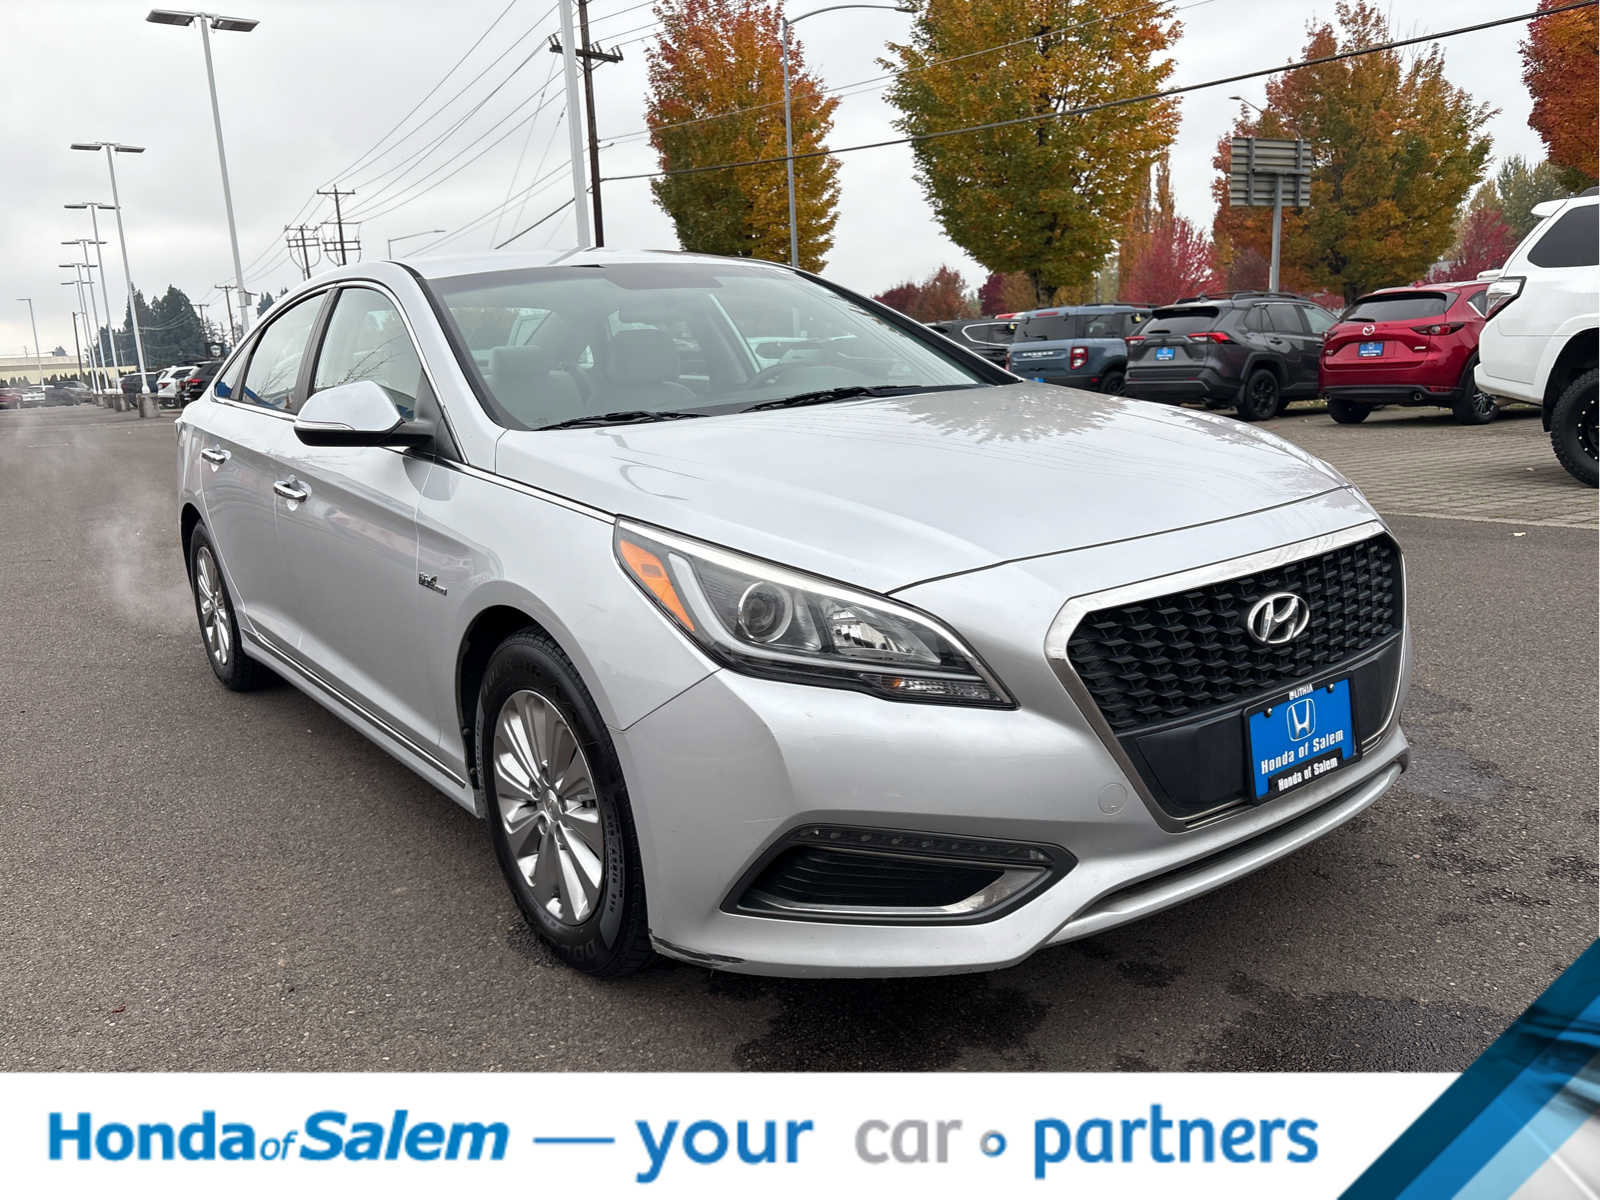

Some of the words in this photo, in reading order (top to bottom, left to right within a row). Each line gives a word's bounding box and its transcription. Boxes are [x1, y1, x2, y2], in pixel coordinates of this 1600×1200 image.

[1261, 750, 1295, 774] Honda
[1298, 741, 1309, 758] of
[1312, 729, 1344, 752] Salem
[1277, 771, 1302, 791] Honda
[1303, 766, 1312, 779] of
[1313, 757, 1338, 775] Salem
